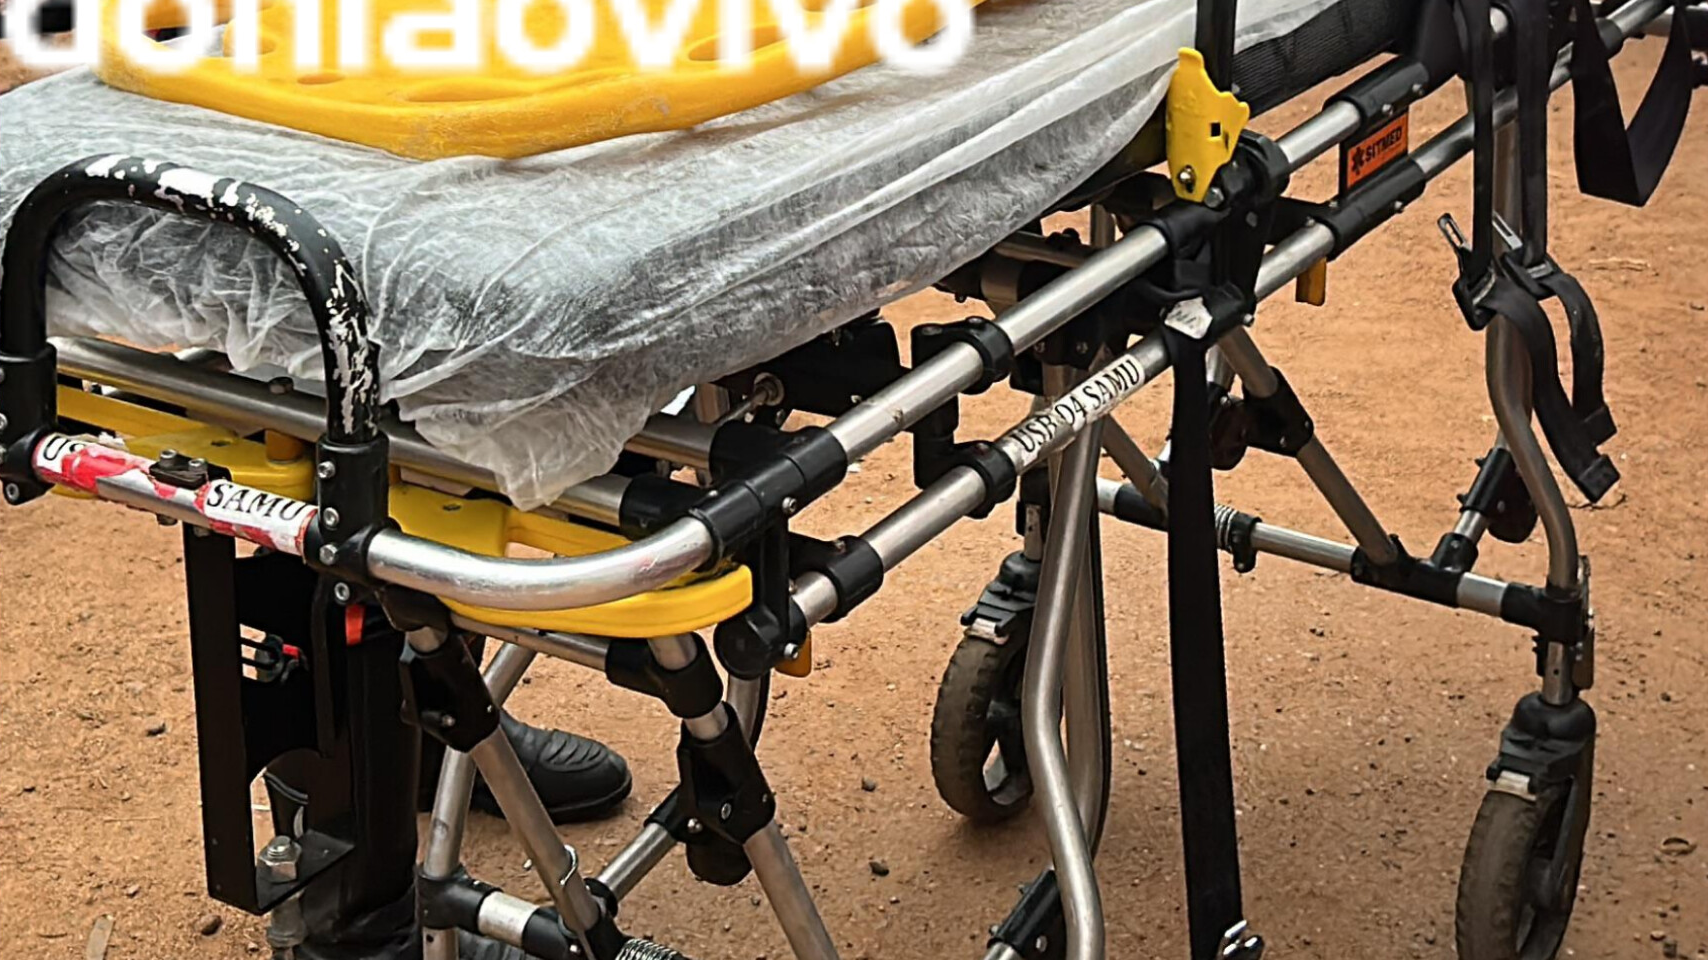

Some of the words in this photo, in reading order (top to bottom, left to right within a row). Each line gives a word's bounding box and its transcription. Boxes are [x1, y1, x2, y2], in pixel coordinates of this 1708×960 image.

[1054, 395, 1088, 427] 04
[1082, 359, 1141, 411] SAMU
[207, 482, 307, 522] SAMU
